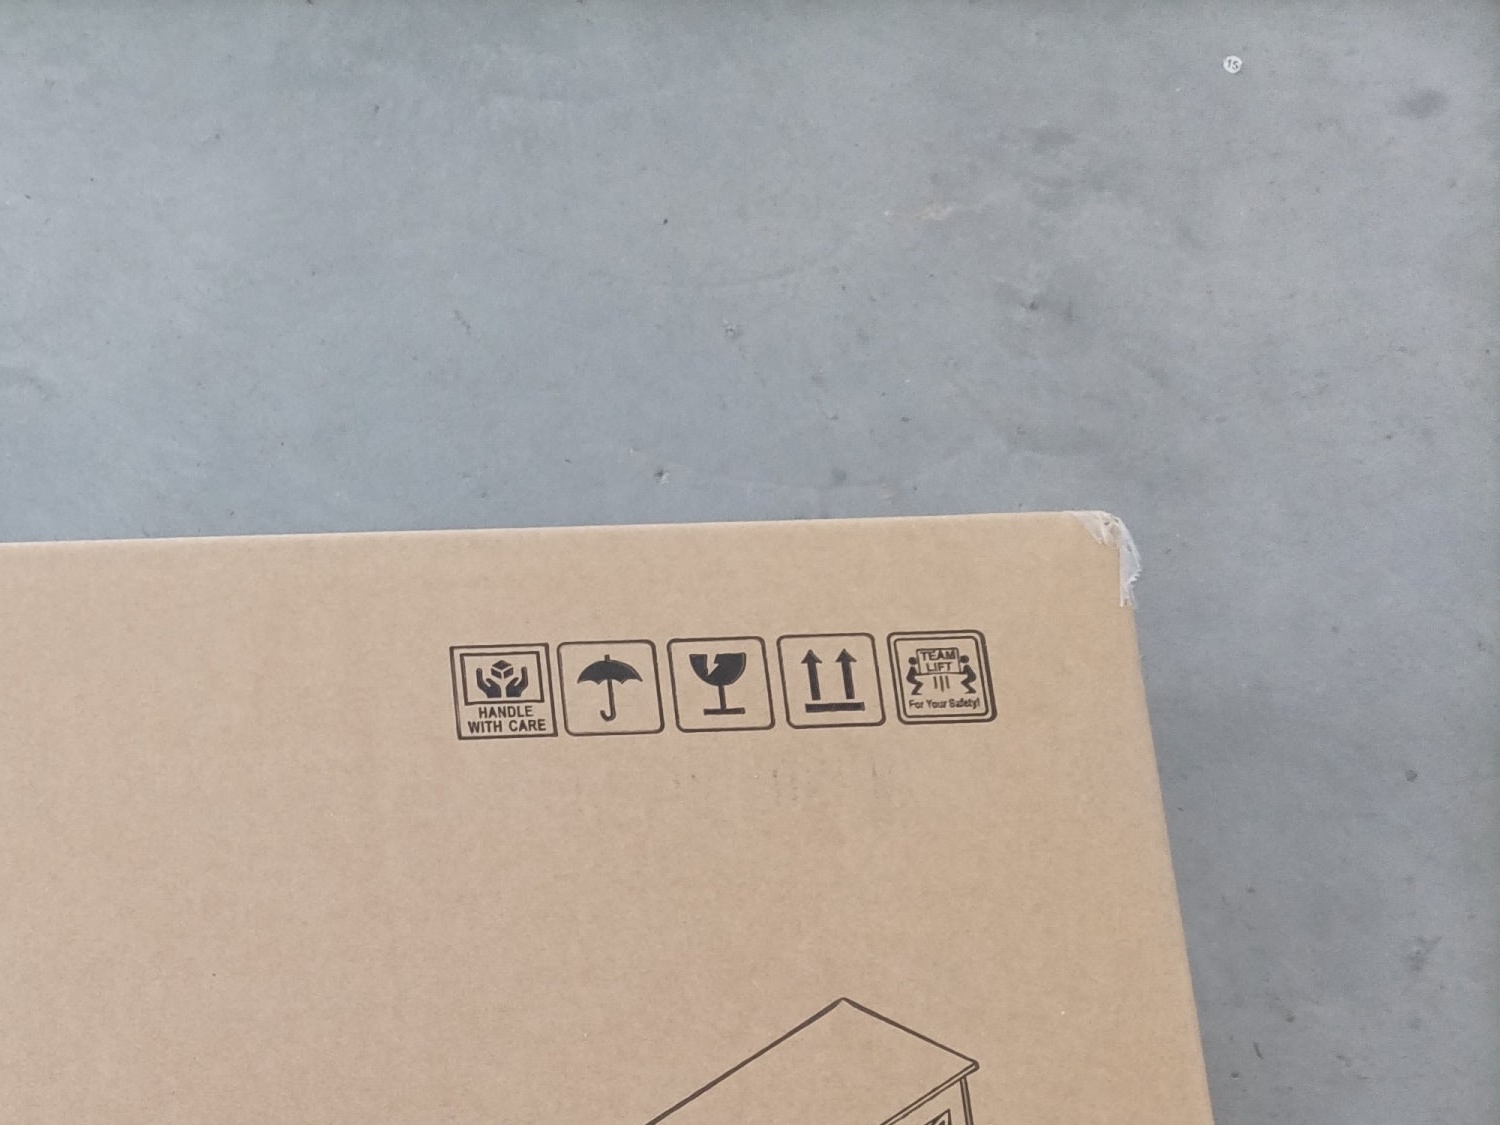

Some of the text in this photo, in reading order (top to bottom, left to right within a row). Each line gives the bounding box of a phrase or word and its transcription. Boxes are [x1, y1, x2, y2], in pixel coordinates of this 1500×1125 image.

[1227, 58, 1239, 70] 15
[920, 650, 956, 661] TEAM
[926, 662, 952, 672] LIFT
[909, 698, 980, 709] For Your Safety!
[478, 705, 534, 719] HANDLE
[467, 718, 547, 734] WITH CARE
